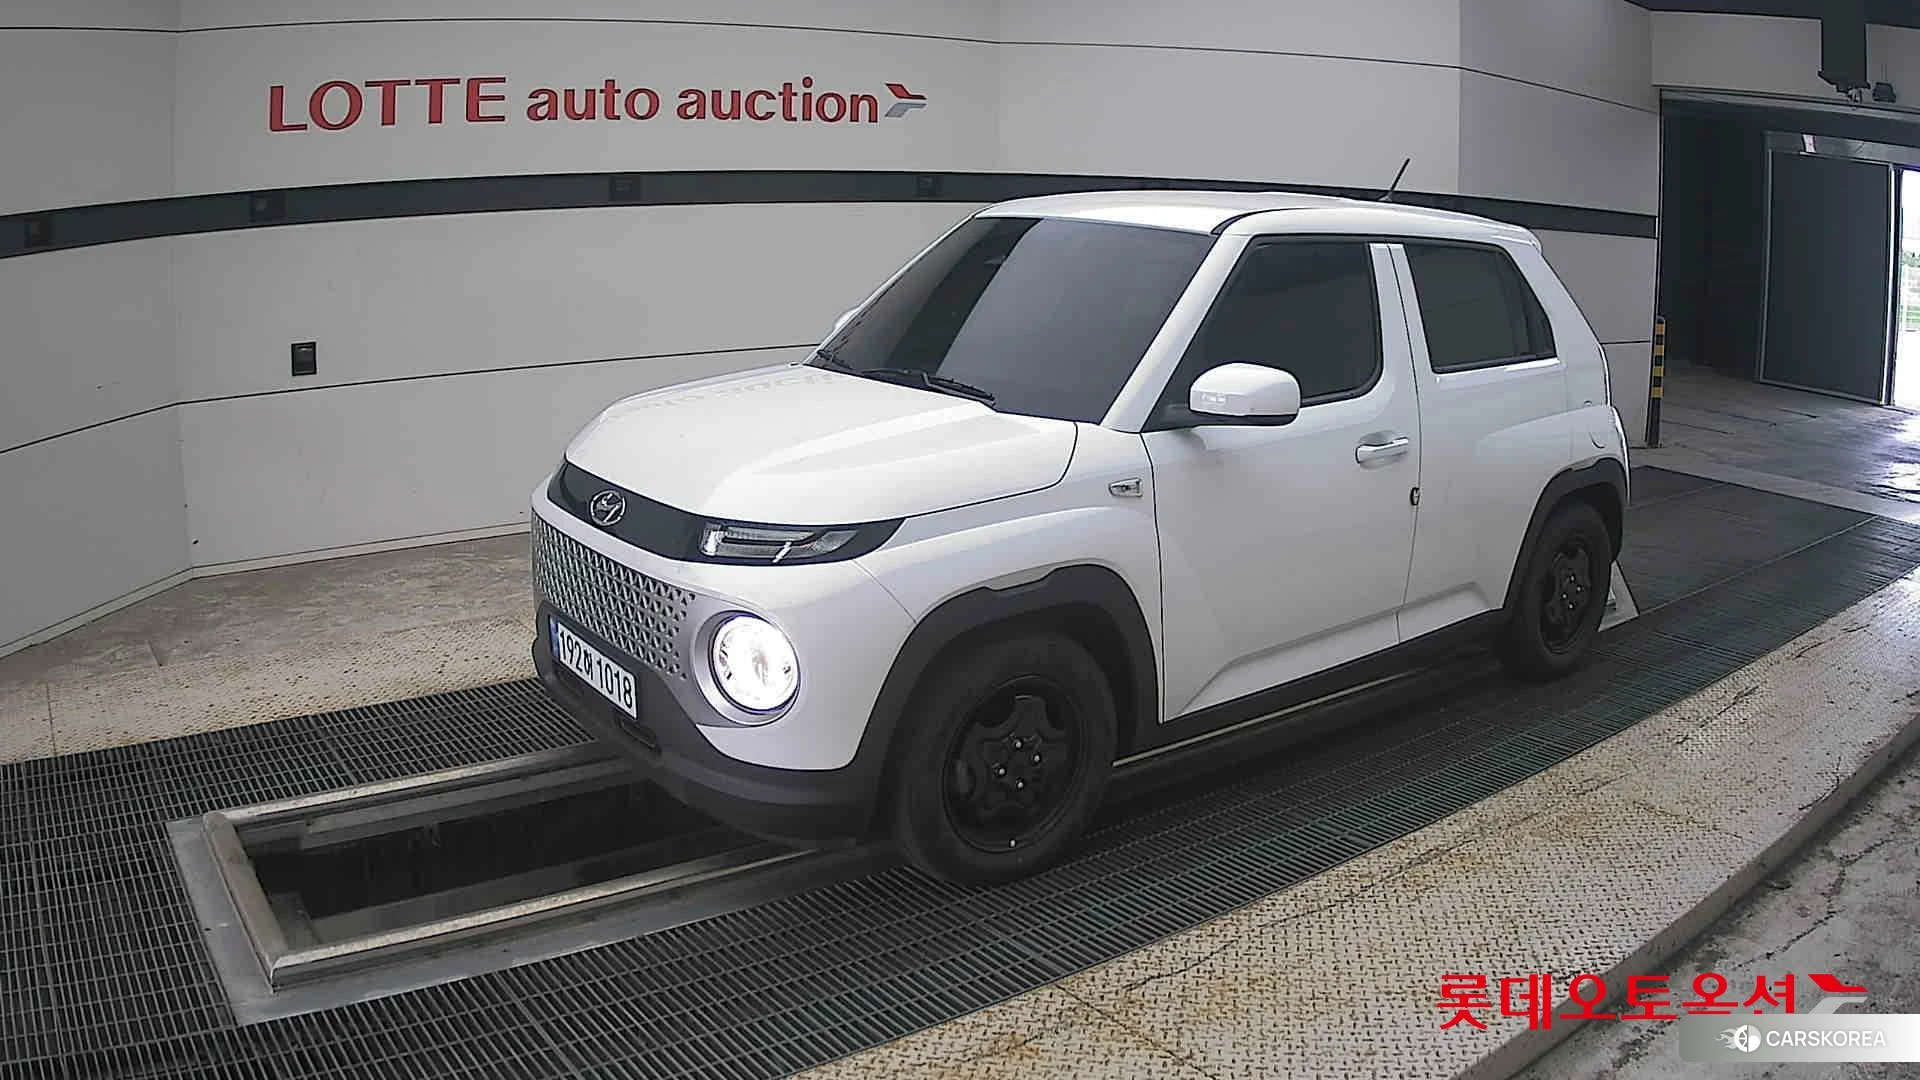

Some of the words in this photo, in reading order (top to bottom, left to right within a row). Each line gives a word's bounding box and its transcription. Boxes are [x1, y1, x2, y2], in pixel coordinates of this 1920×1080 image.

[269, 77, 506, 132] LOTTE
[527, 79, 660, 121] auto
[677, 77, 878, 123] auction
[597, 658, 633, 709] 1018
